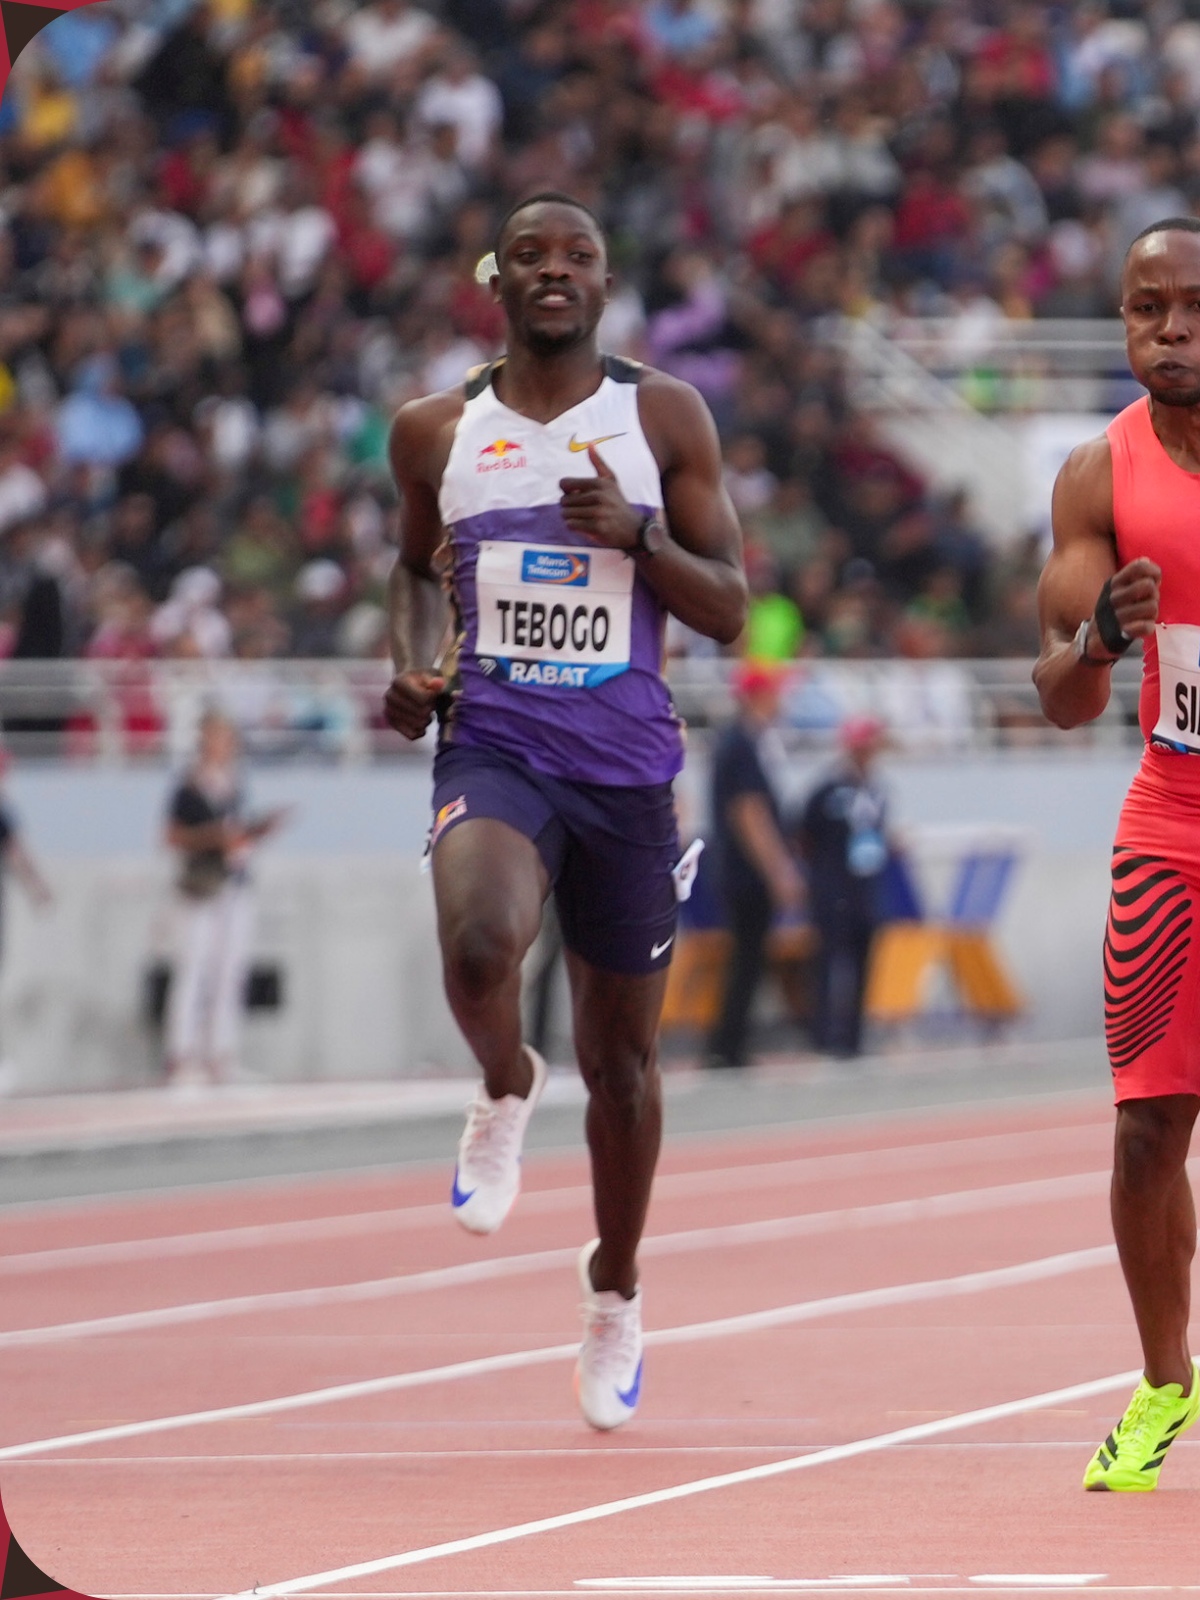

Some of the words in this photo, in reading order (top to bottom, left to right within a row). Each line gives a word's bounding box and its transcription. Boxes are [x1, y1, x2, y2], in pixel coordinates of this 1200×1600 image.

[476, 460, 500, 473] Red
[502, 456, 527, 470] Bull
[537, 555, 570, 567] Maroc
[496, 599, 609, 651] TEBOGO
[509, 662, 590, 686] RABAT
